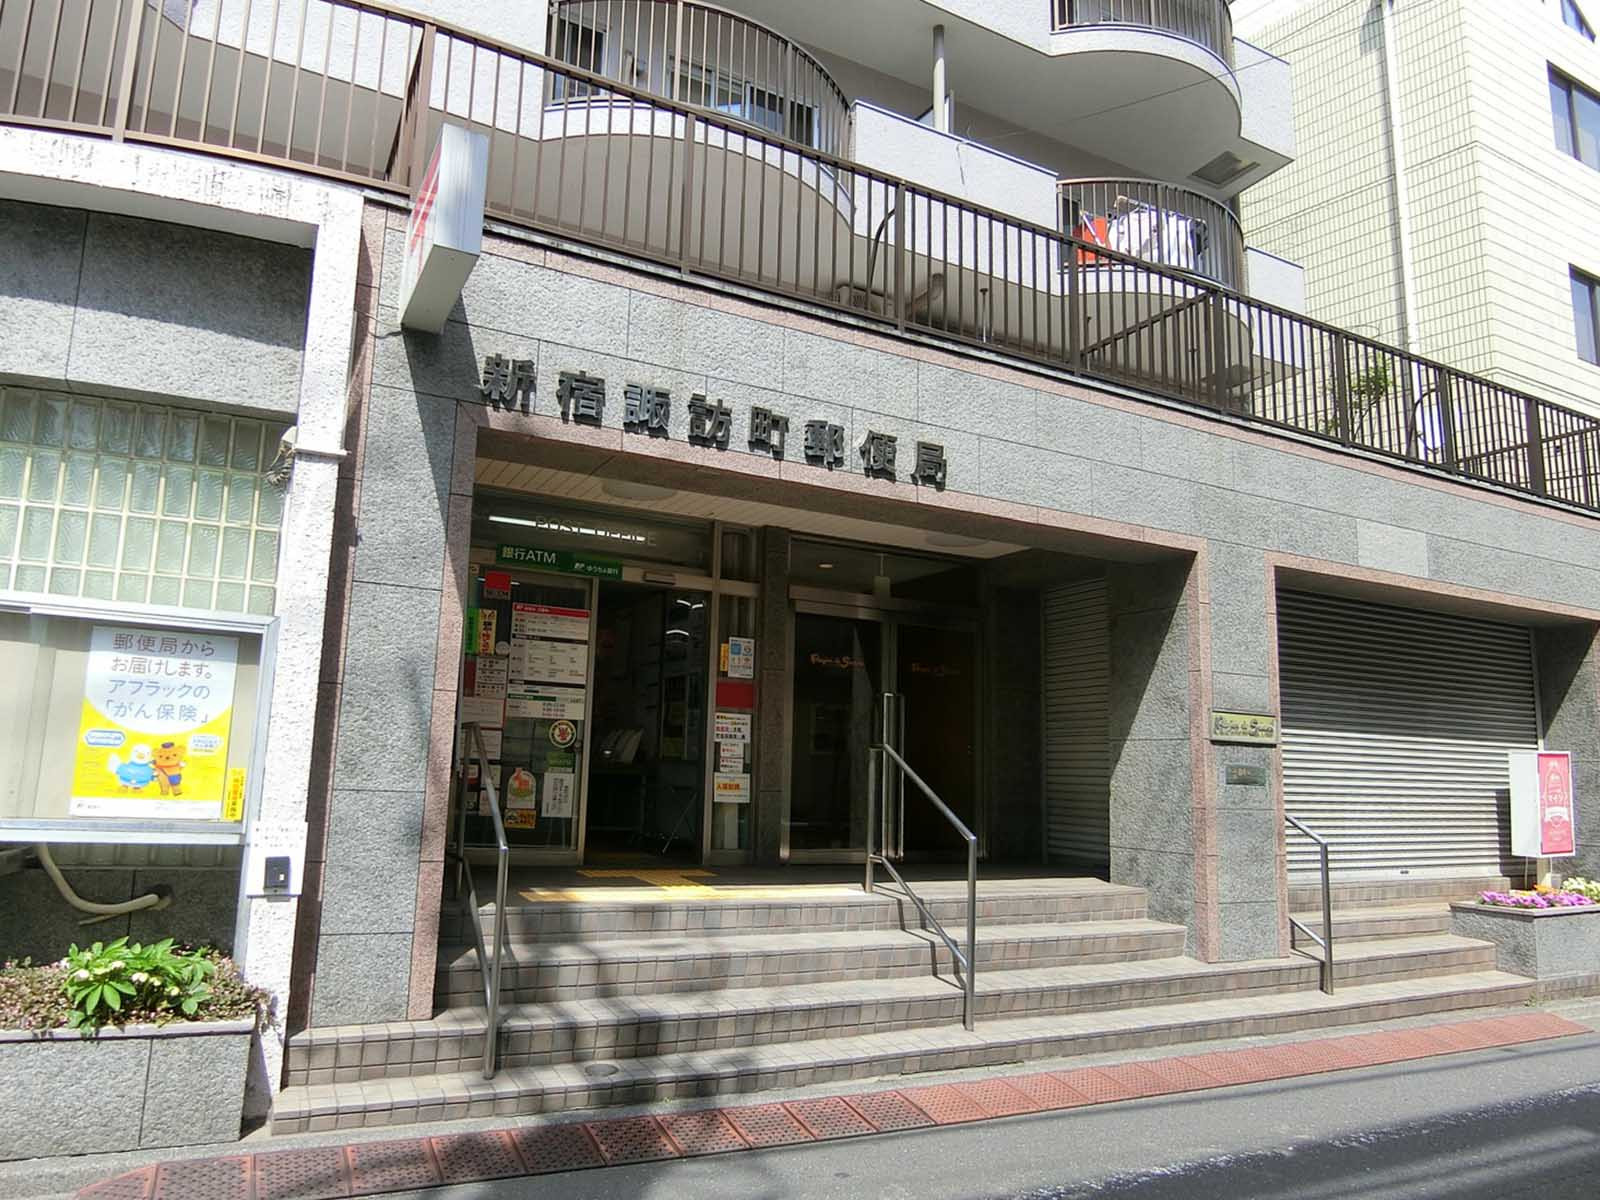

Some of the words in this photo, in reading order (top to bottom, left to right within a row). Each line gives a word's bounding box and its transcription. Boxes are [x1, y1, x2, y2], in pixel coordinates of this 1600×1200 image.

[482, 352, 947, 490] 新宿諏訪町郵便局
[502, 546, 556, 565] 銀行ATM
[113, 633, 215, 656] 郵便局から
[112, 657, 213, 679] お届けします。
[109, 680, 210, 700] アフラックの
[105, 701, 209, 724] 「がん保険」
